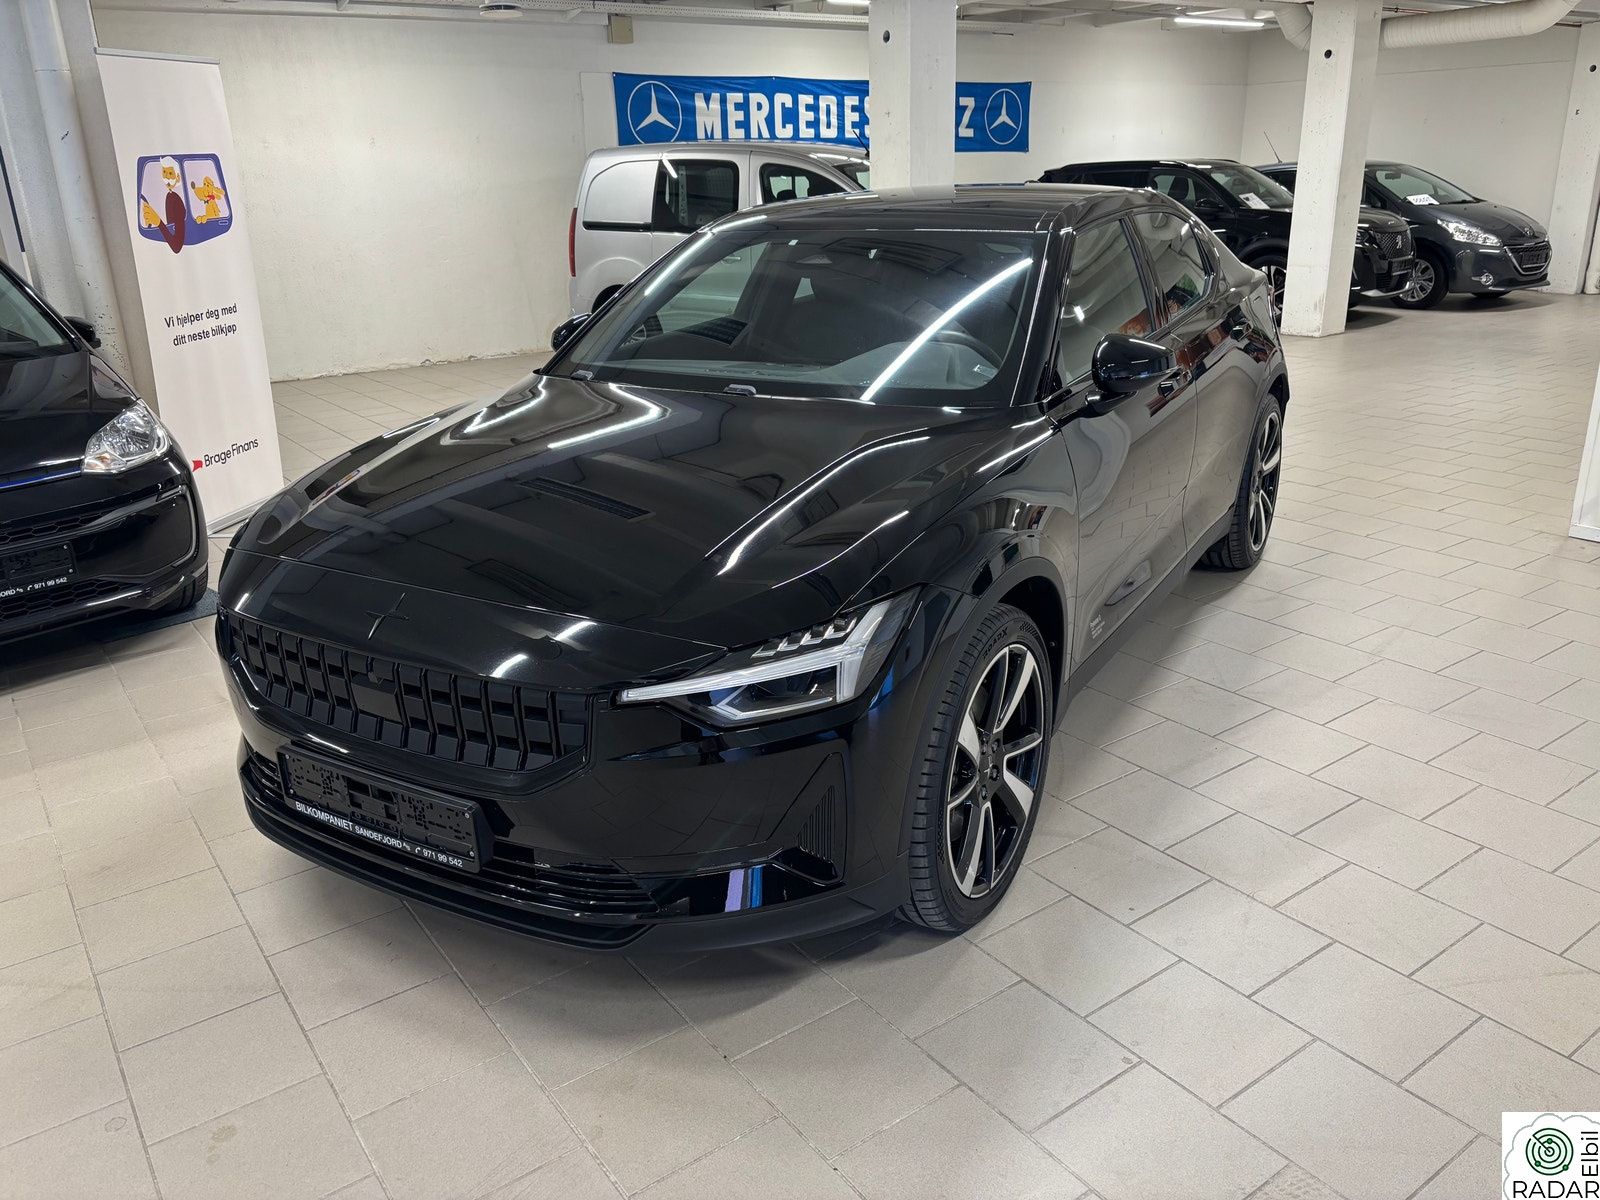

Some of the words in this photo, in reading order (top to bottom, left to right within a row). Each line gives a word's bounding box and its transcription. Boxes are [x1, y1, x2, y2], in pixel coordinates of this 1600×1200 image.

[163, 316, 175, 328] Vi
[176, 312, 204, 328] hjelper
[205, 308, 220, 320] deg
[221, 303, 238, 316] med
[173, 334, 187, 346] ditt
[187, 329, 210, 343] neste
[210, 323, 237, 337] bilkjøp
[203, 449, 232, 468] Brage
[231, 439, 259, 456] Finans
[34, 582, 46, 590] 971
[56, 577, 68, 585] 542
[295, 801, 354, 831] BILKOMPANIET
[354, 825, 402, 849] SANDEFJORD
[422, 848, 436, 859] 971
[437, 853, 448, 863] 99
[448, 857, 463, 868] 542
